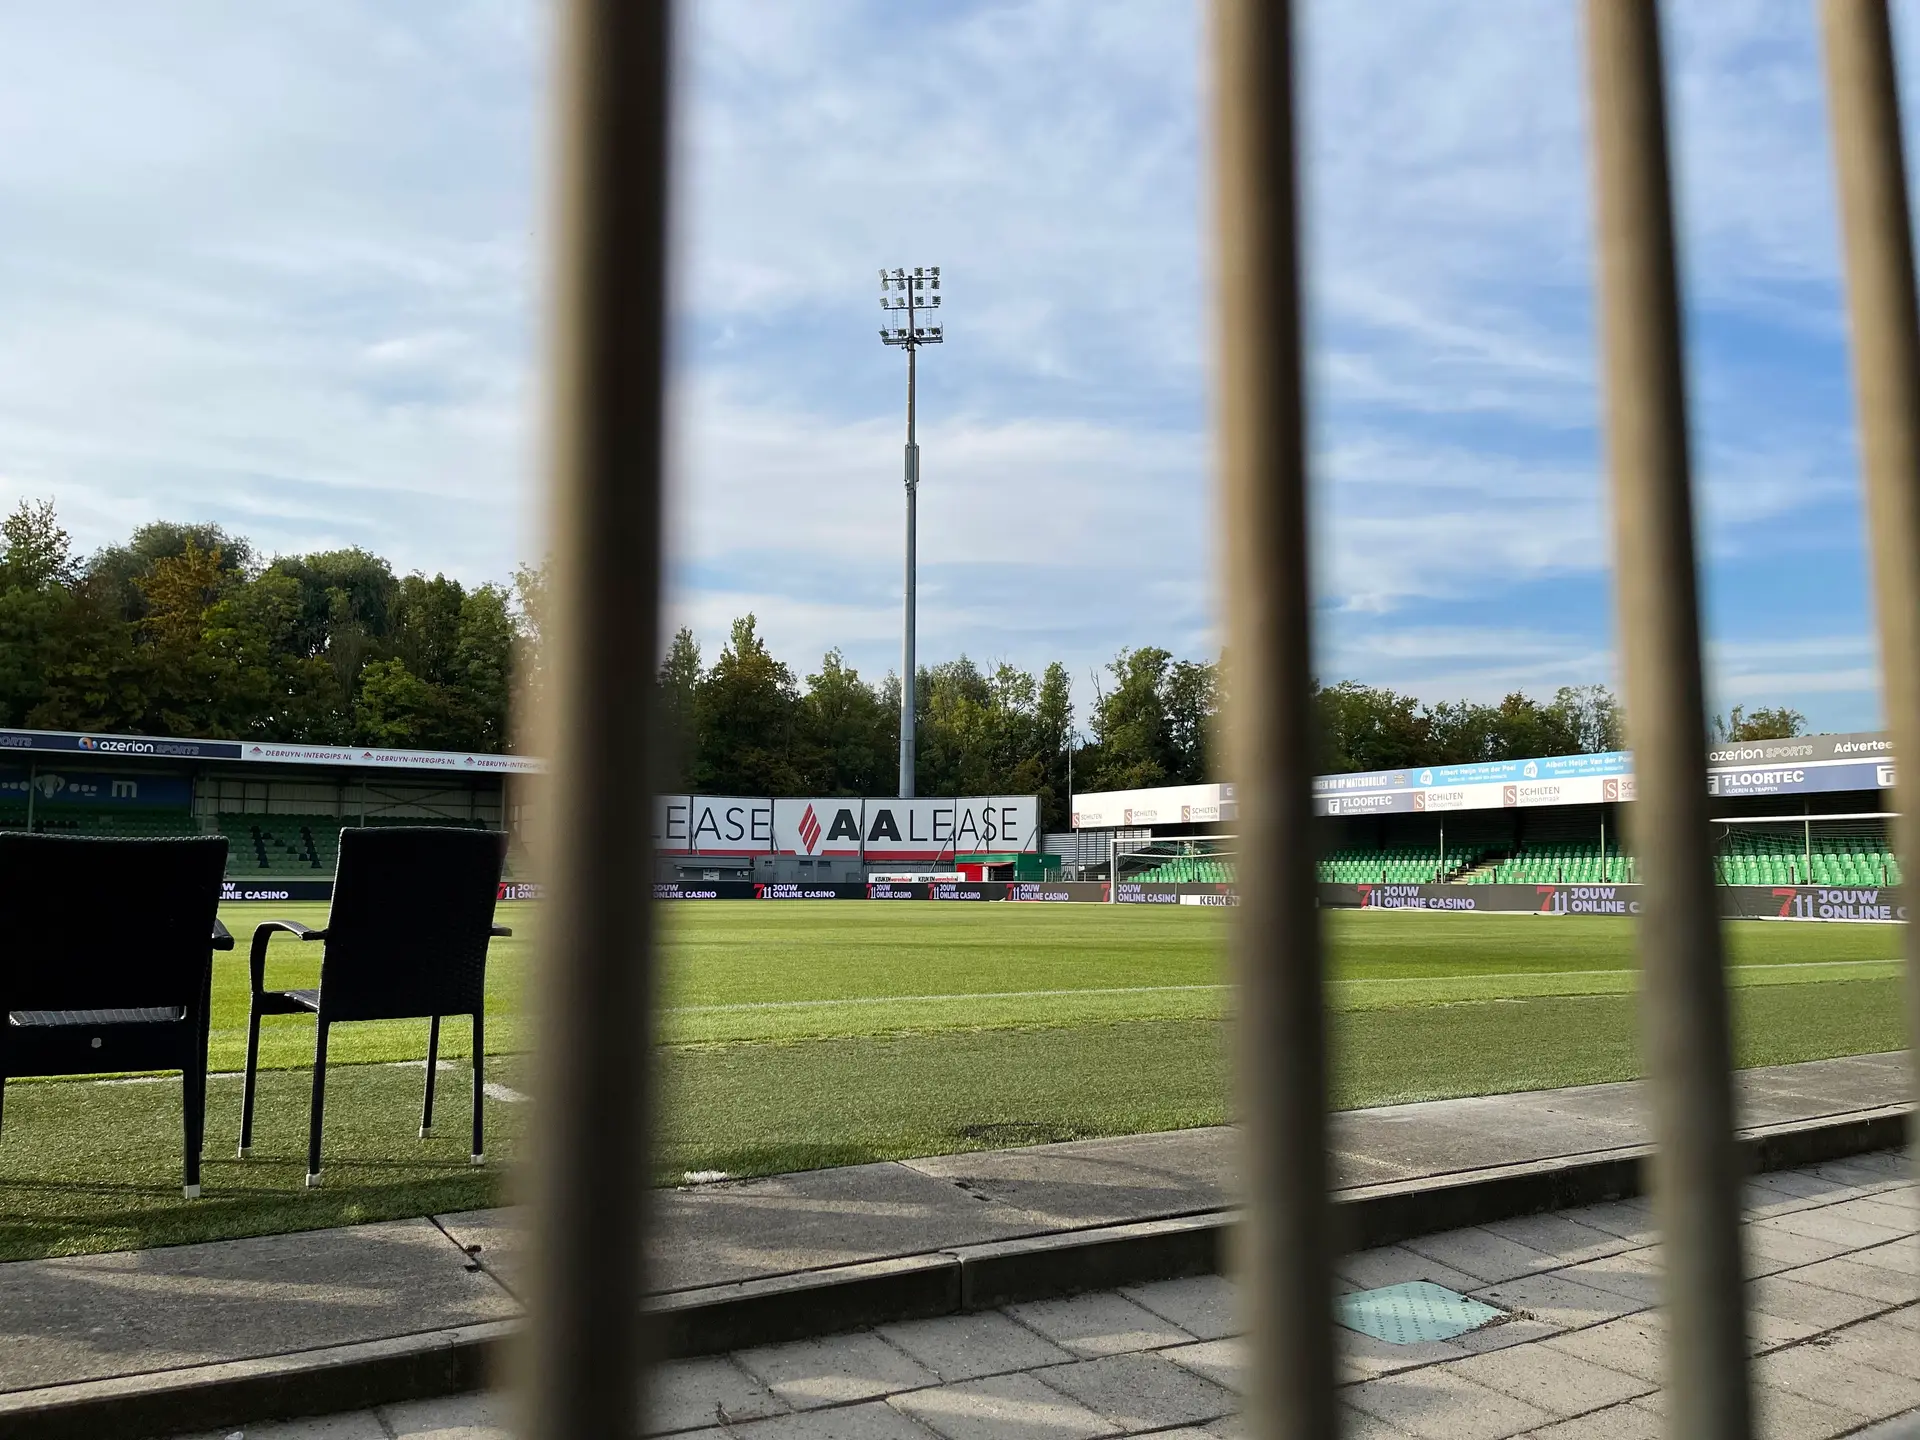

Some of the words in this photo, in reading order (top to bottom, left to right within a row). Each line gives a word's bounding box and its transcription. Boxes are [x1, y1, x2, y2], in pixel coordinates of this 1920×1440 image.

[0, 735, 33, 747] ORTS
[1833, 739, 1894, 754] Advertee
[100, 739, 154, 753] azerion
[156, 744, 200, 756] SPORTS
[1709, 747, 1764, 762] azerion
[1766, 744, 1813, 758] SPORTS
[265, 749, 353, 761] DEBRUYN-INTERGIPS.NL
[375, 755, 456, 765] DEBRUYN-INTERGIPS.NL
[1721, 770, 1805, 787] FLOORTEC
[1427, 792, 1464, 802] SCHILTEN
[1519, 786, 1560, 796] SCHILTEN
[1342, 795, 1392, 807] FLOORTEC
[1133, 809, 1158, 817] SCHILTEN
[1191, 806, 1218, 815] SCHILTEN
[651, 805, 770, 841] EASE
[653, 884, 679, 892] JOUW
[753, 883, 773, 899] 711
[773, 884, 798, 892] JOUW
[866, 883, 876, 900] 711
[928, 883, 940, 900] 711
[1006, 884, 1020, 900] 711
[1020, 884, 1040, 892] JOUW
[1118, 884, 1142, 893] JOUW
[219, 891, 242, 899] INE
[244, 890, 289, 899] CASINO
[653, 891, 683, 899] ONLINE
[685, 891, 717, 899] CASINO
[804, 891, 836, 899] CASINO
[893, 891, 912, 899] CASINO
[940, 891, 960, 899] ONLINE
[960, 891, 981, 899] CASINO
[1020, 892, 1044, 900] ONLINE
[1044, 892, 1069, 900] CASINO
[1118, 893, 1146, 902] ONLINE
[1357, 884, 1382, 907] 711
[1384, 886, 1420, 897] JOUW
[1536, 886, 1570, 913] 711
[1571, 887, 1616, 899] JOUW
[1384, 898, 1426, 908] ONLINE
[1429, 898, 1476, 910] CASINO
[1571, 900, 1626, 913] ONLINE
[1771, 887, 1814, 919] 711
[1818, 889, 1878, 904] JOUW
[1819, 905, 1891, 919] ONLINE
